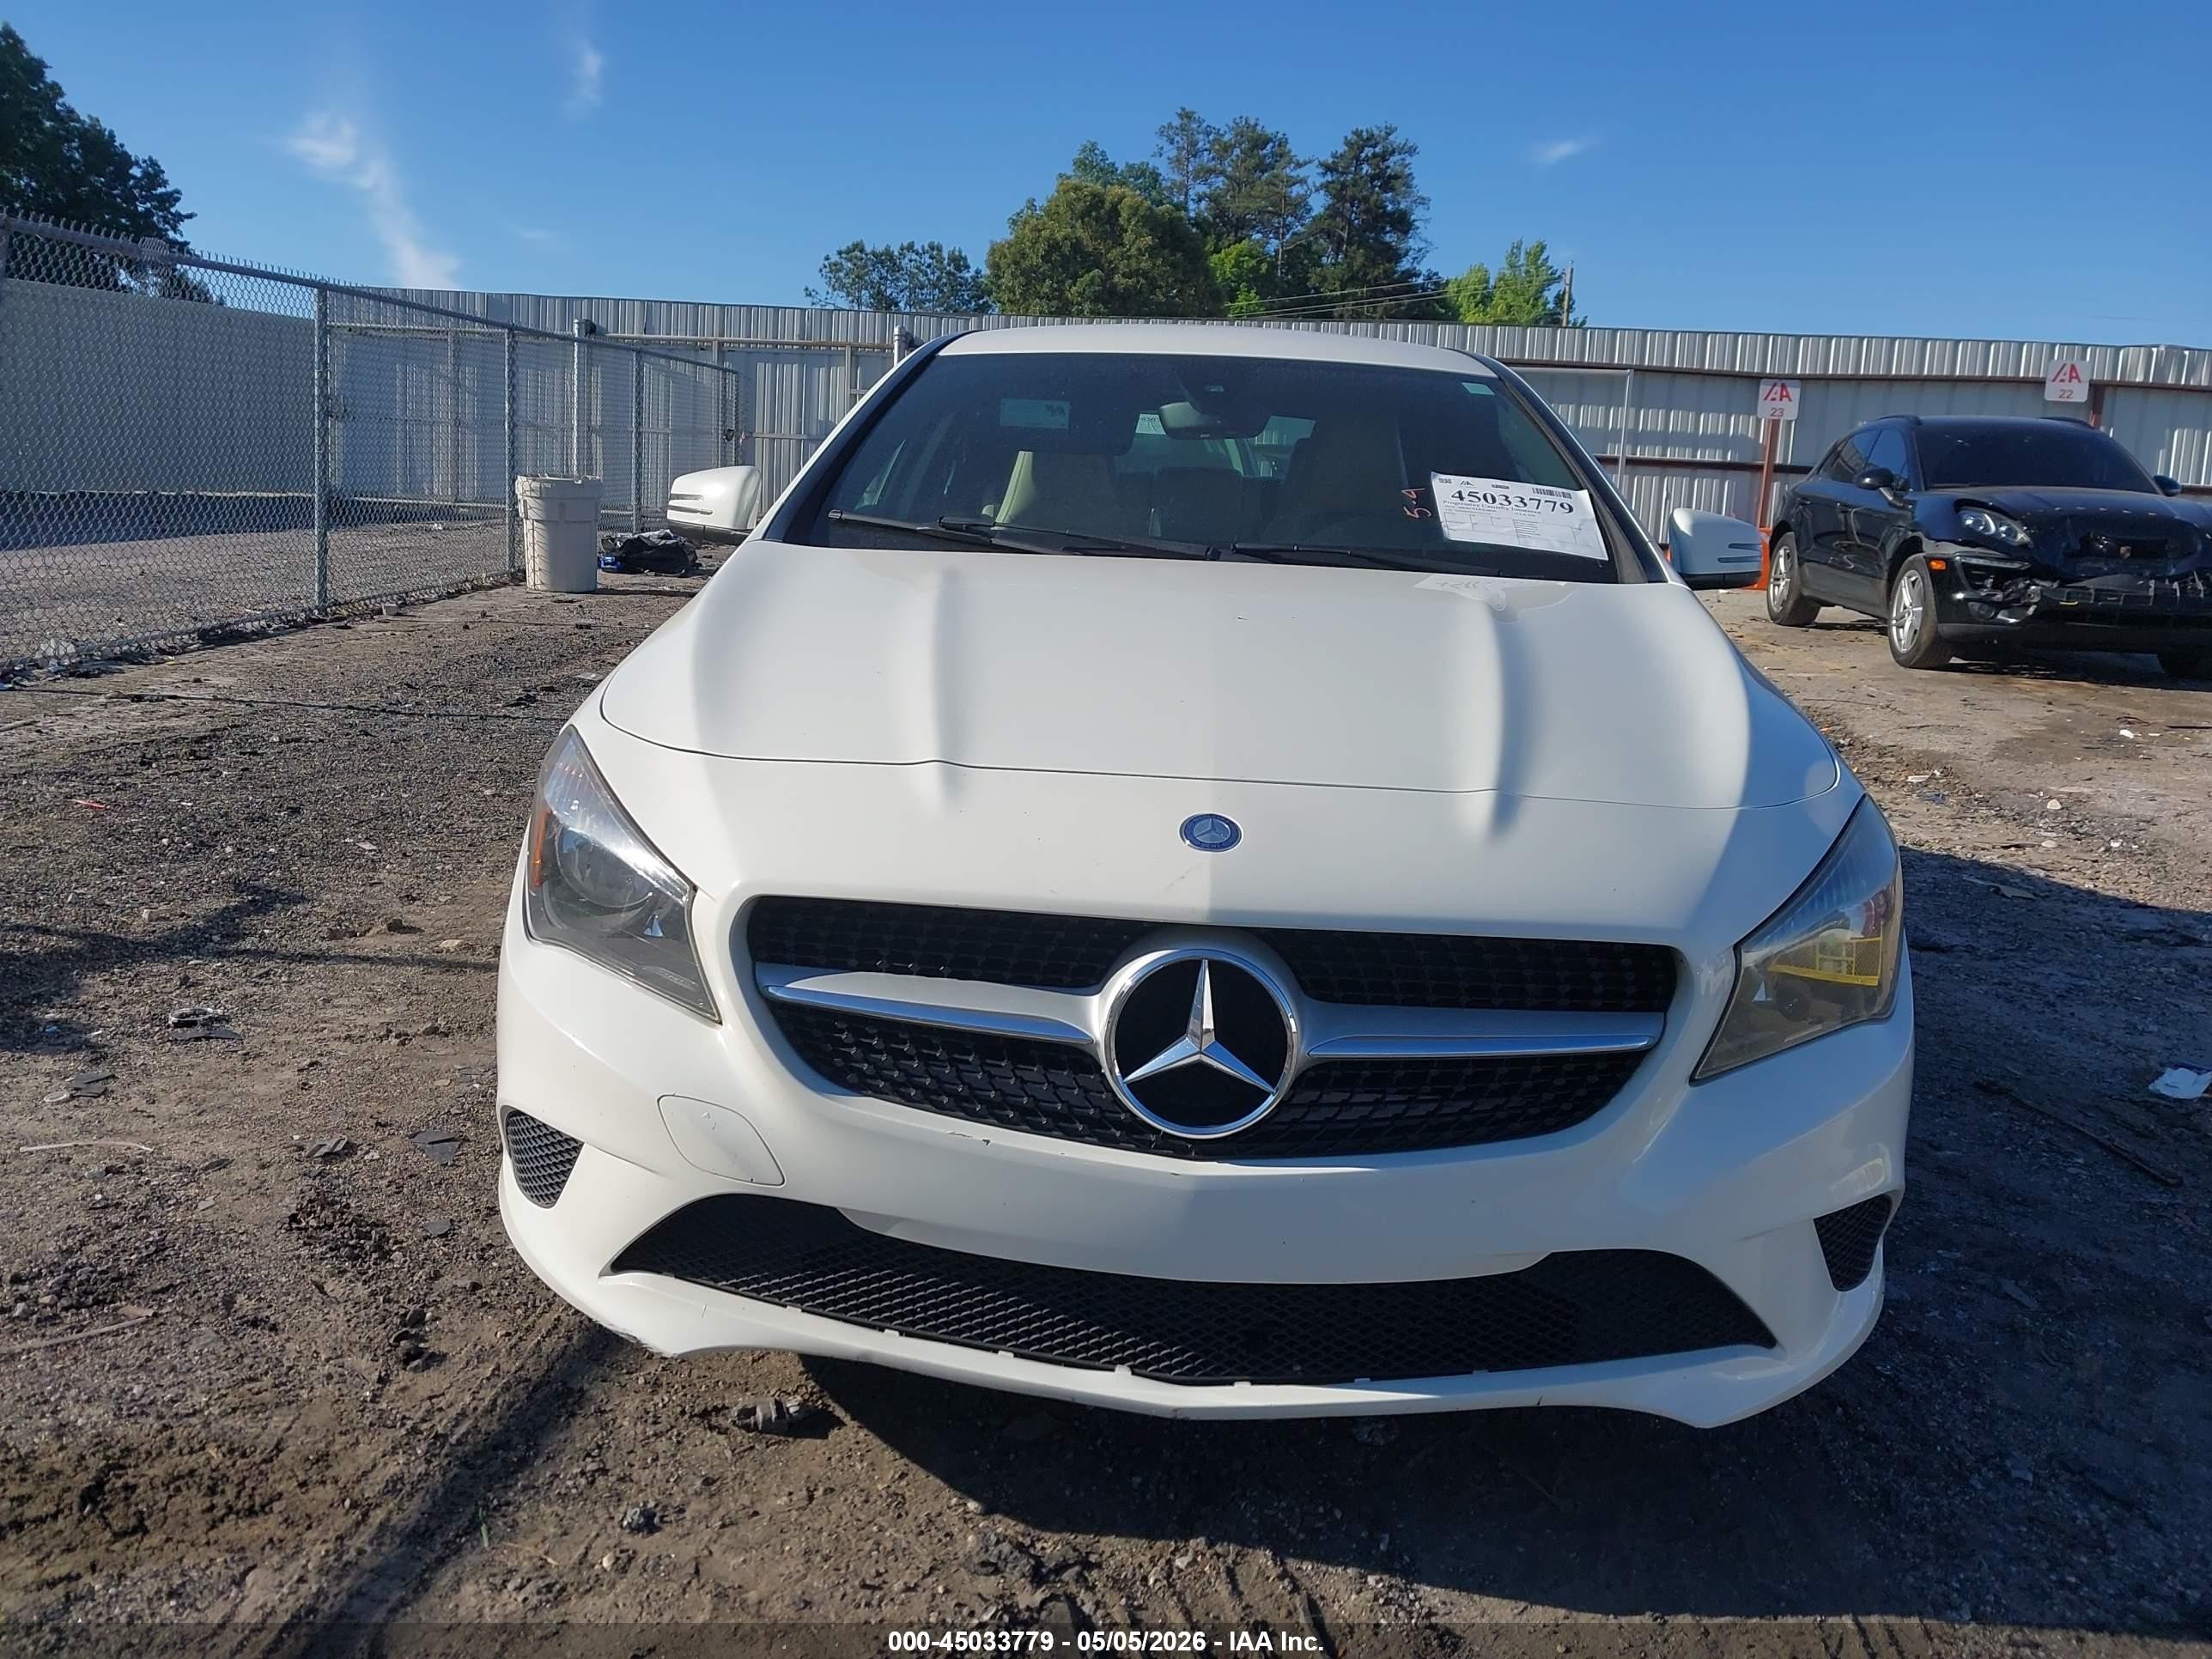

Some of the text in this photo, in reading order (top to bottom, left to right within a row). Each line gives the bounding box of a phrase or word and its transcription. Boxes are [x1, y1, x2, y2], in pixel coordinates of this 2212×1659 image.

[2059, 389, 2075, 398] 22
[1771, 407, 1785, 417] 23
[1451, 489, 1574, 514] 45033779
